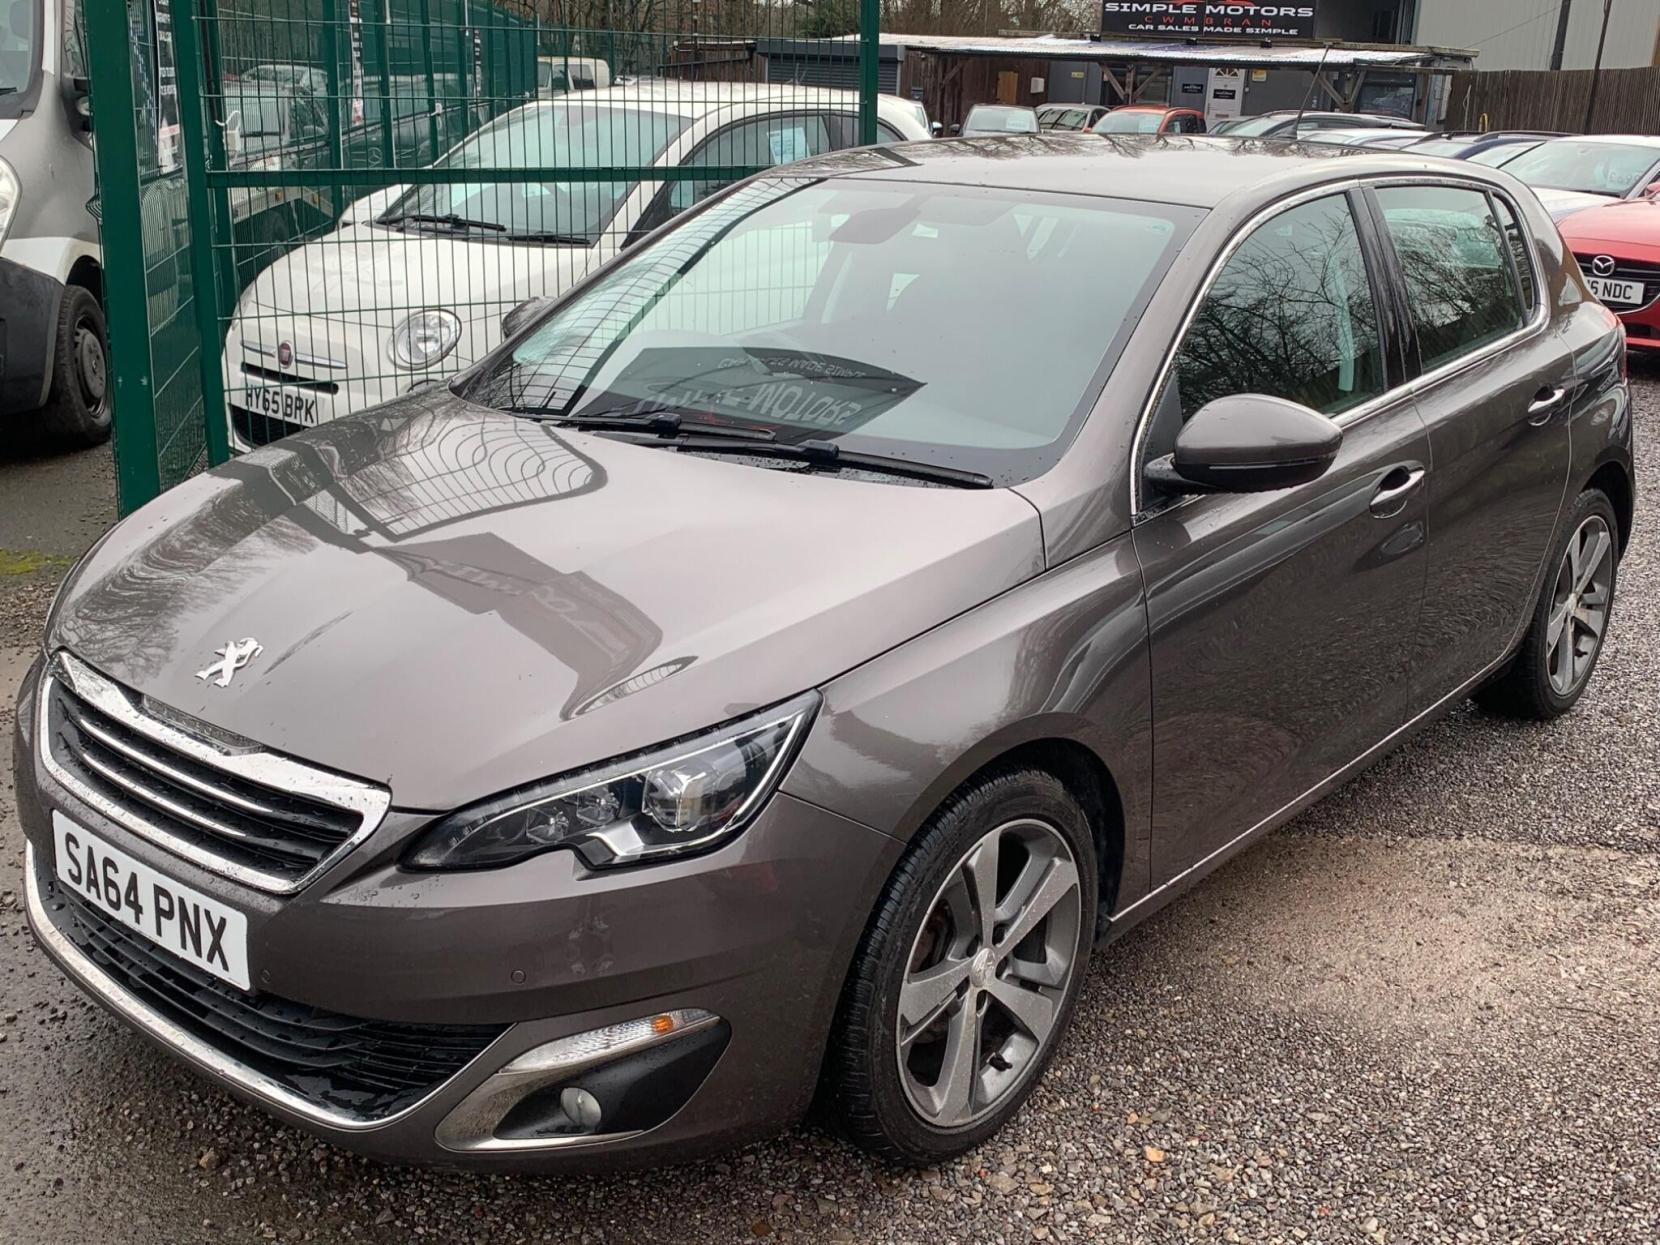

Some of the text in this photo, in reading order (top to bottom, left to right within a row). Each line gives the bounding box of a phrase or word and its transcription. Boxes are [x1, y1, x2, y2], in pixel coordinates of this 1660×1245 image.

[1105, 2, 1313, 17] SIMPLE MOTORS
[1128, 23, 1154, 31] CAR
[1157, 24, 1199, 32] SALES
[1245, 27, 1299, 35] SIMPLE
[1144, 15, 1272, 27] CWMBRAN
[1587, 279, 1633, 300] 6 NDC
[245, 384, 280, 415] HY65
[65, 832, 230, 973] SA64 PNX
